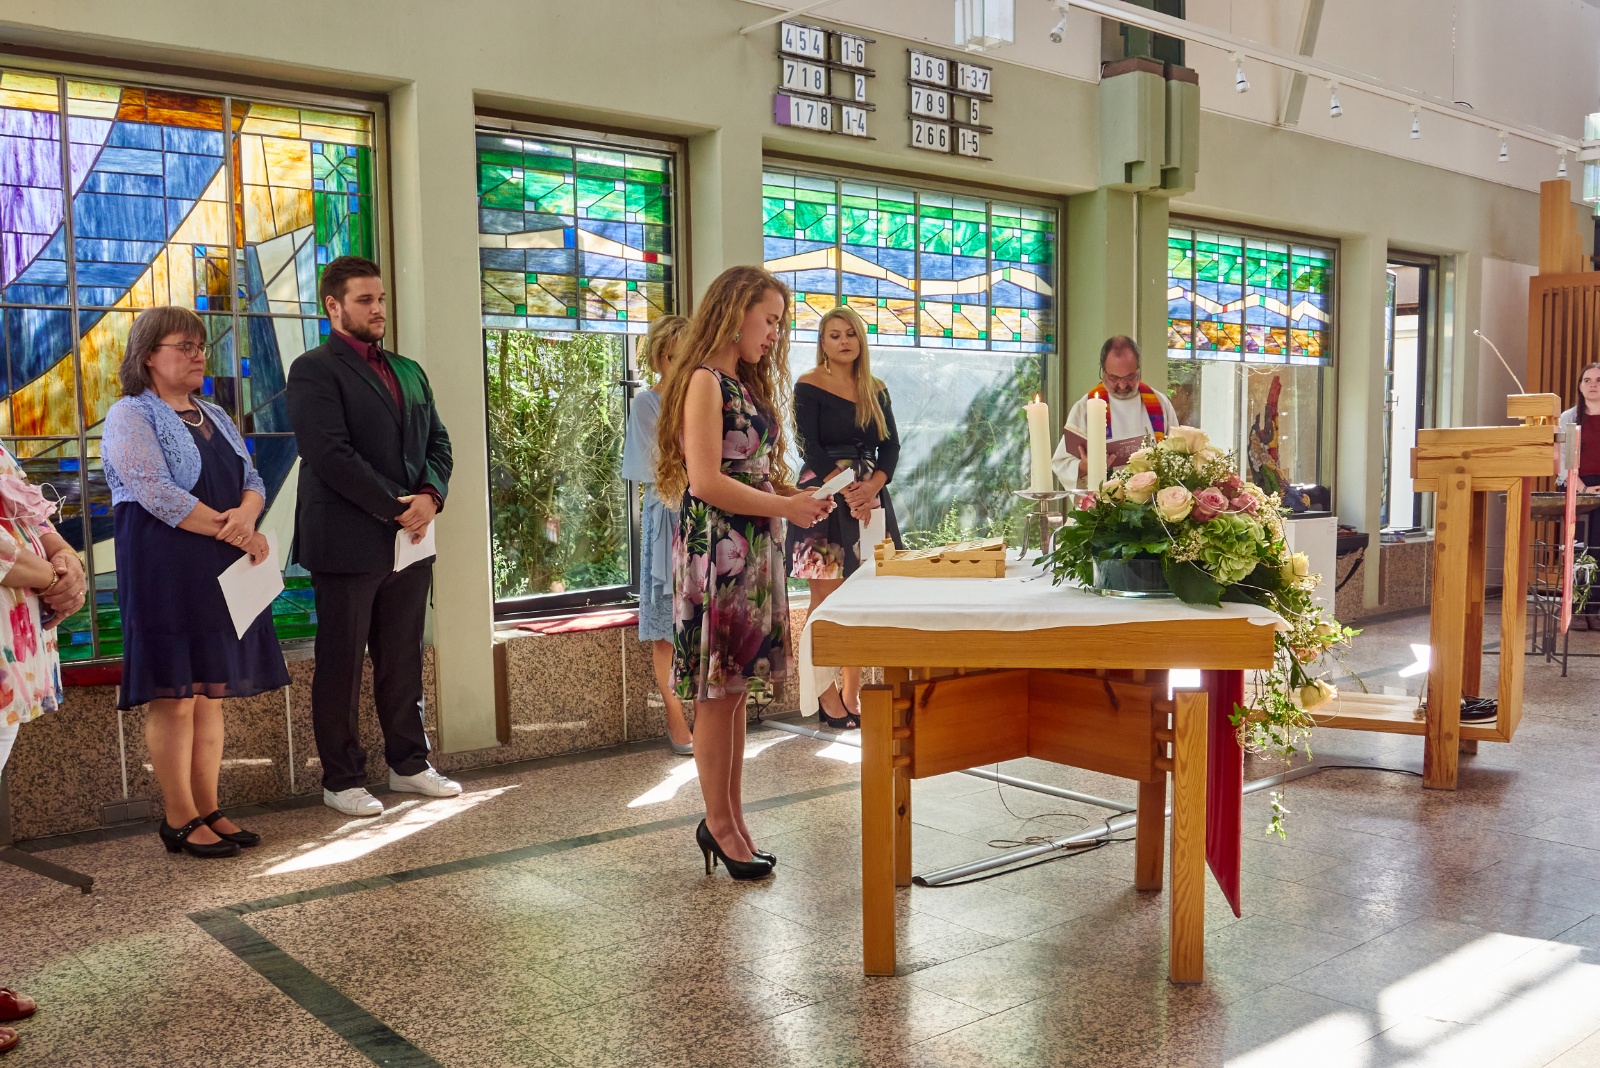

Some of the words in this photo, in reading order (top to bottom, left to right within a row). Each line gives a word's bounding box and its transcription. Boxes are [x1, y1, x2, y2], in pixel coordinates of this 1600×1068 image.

[785, 28, 820, 54] 454
[844, 41, 863, 63] 1-6
[787, 64, 821, 90] 718
[857, 78, 863, 98] 2
[914, 57, 944, 81] 369
[795, 102, 828, 126] 178
[845, 110, 864, 132] 1-4
[915, 91, 945, 114] 789
[972, 102, 978, 121] 5
[915, 124, 946, 147] 266
[961, 132, 978, 153] 1-5
